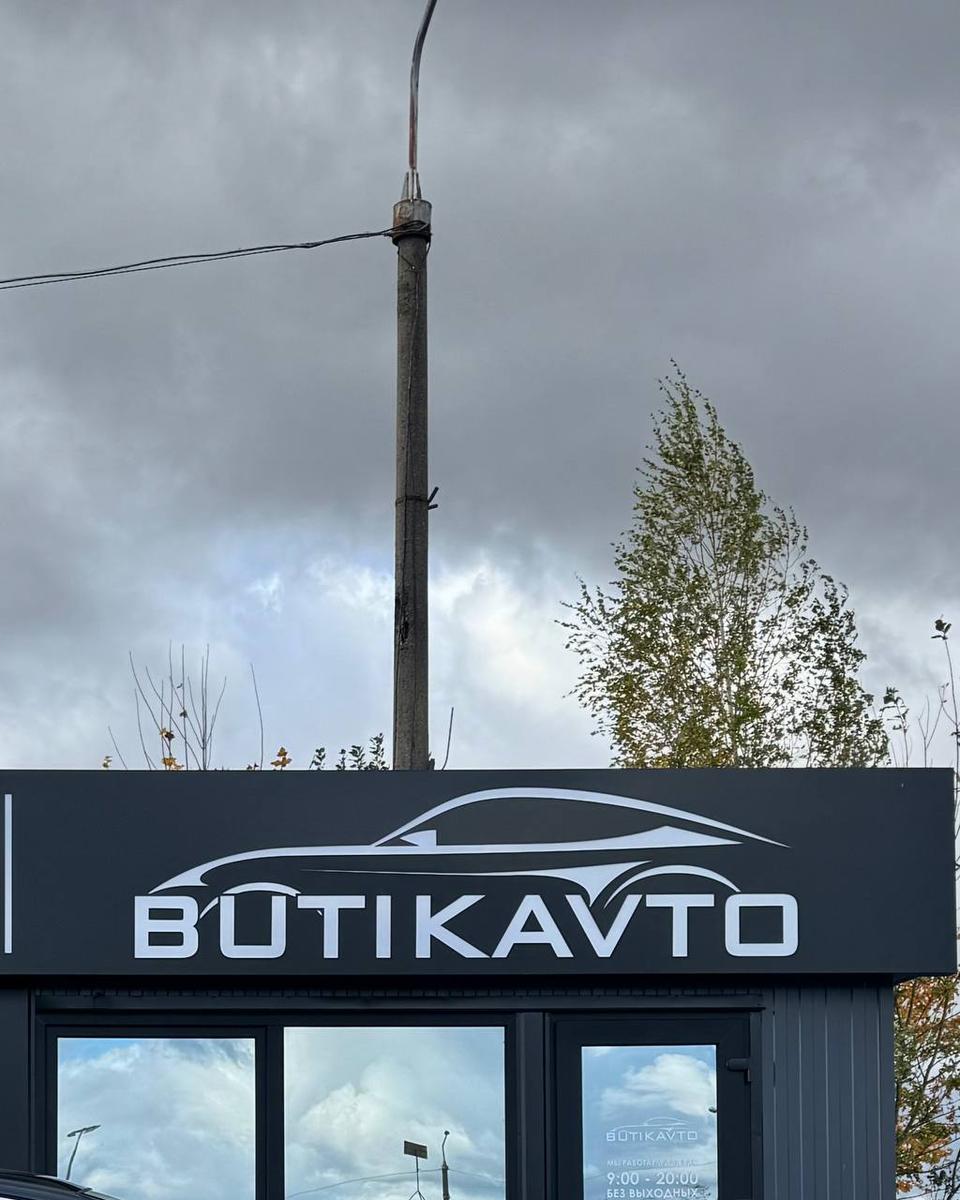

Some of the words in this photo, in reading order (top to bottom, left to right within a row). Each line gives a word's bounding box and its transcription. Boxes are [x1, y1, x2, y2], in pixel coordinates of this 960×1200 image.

[133, 892, 800, 960] BUTIKAVTO
[606, 1131, 698, 1142] BUTIKAVTO
[607, 1172, 640, 1186] 9:00
[656, 1172, 699, 1186] 20:00
[607, 1188, 626, 1198] БЕЗ
[629, 1188, 698, 1199] ВЫХОДНЫХ
